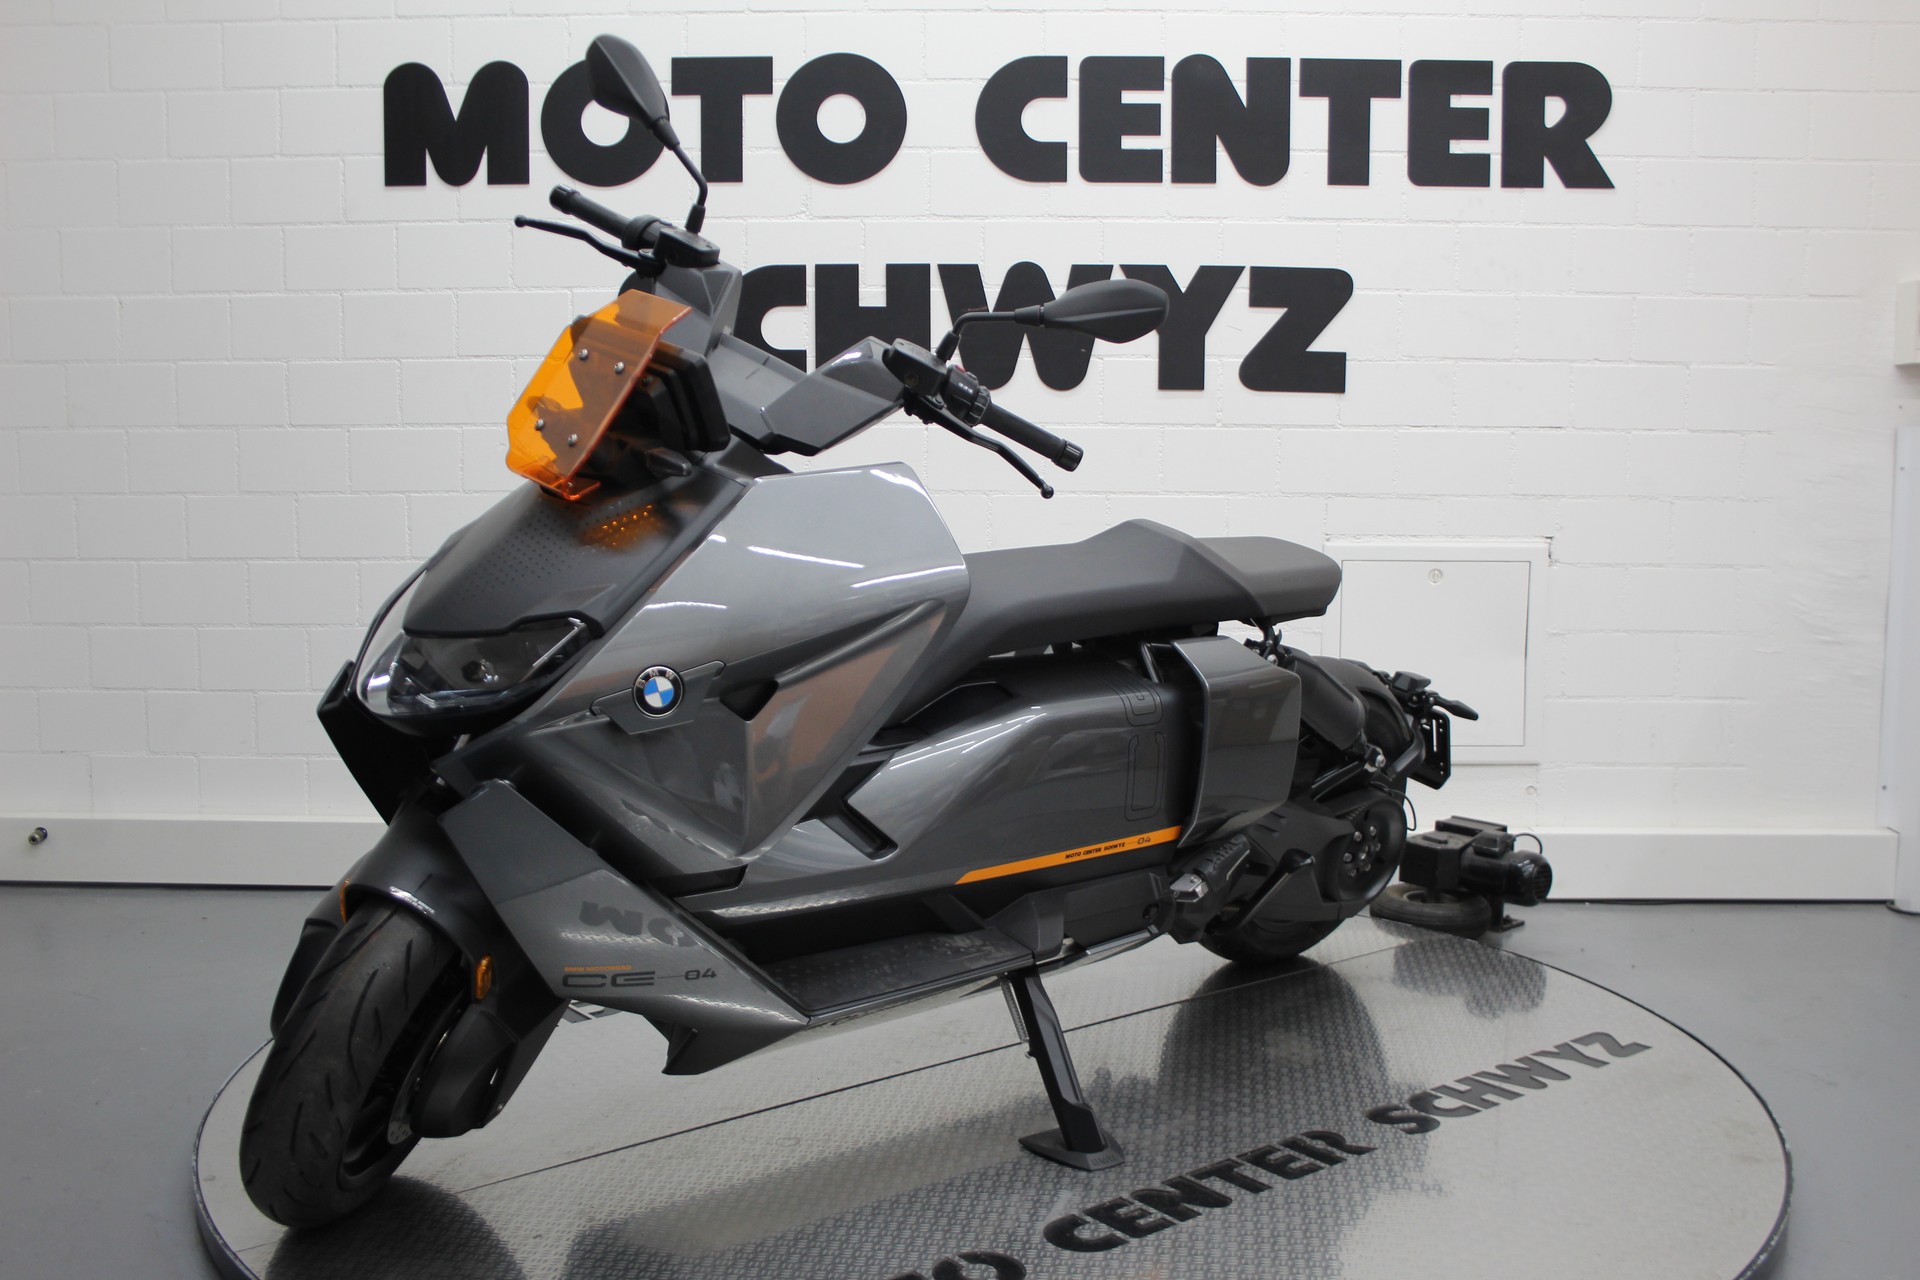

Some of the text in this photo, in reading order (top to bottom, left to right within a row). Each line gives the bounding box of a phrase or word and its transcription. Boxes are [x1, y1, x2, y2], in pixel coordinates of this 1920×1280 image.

[383, 52, 1615, 189] MOTO CENTER
[618, 262, 1354, 394] CHWYZ
[636, 669, 676, 689] BMW
[1137, 836, 1151, 844] 04
[562, 968, 717, 988] CE 04
[1043, 1031, 1652, 1253] CENTER SCHWYZ
